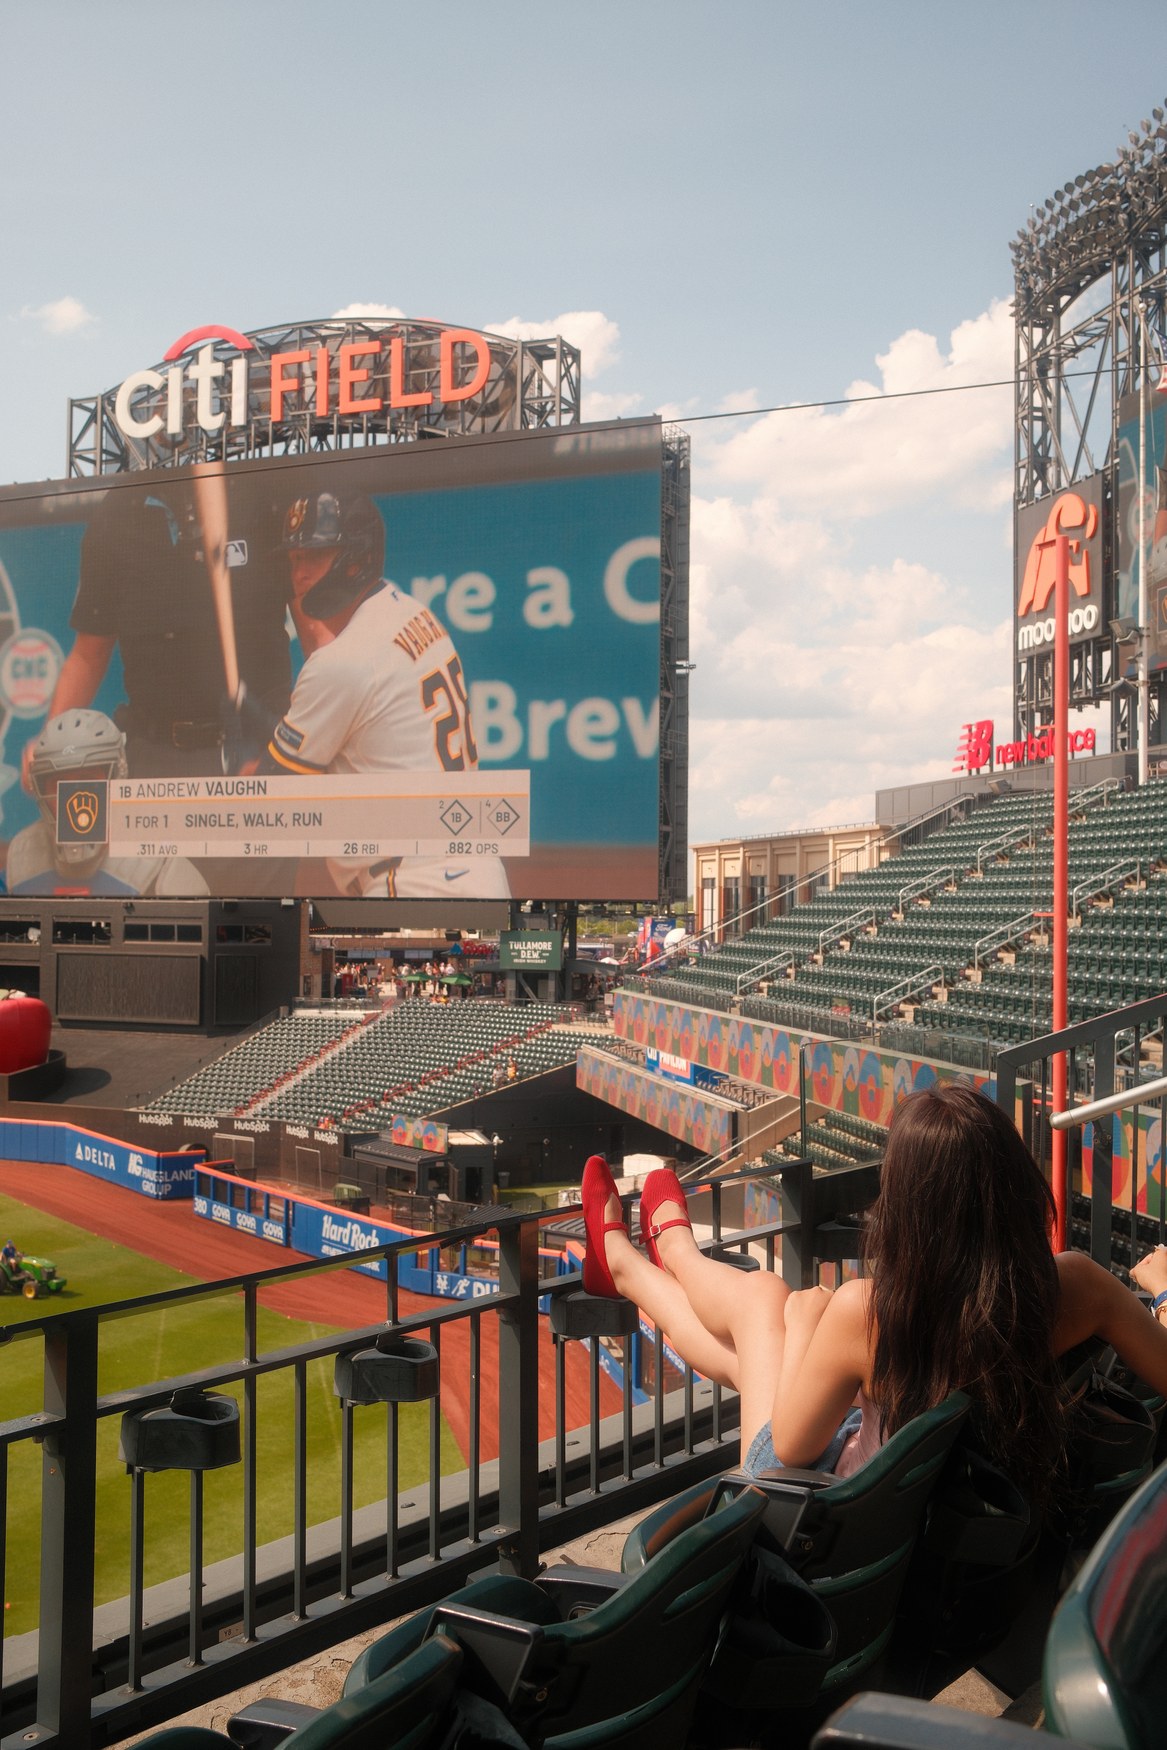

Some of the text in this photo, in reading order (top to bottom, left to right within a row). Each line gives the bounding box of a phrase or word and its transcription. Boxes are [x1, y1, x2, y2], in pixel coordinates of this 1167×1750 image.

[114, 329, 491, 439] citi FIELD
[522, 565, 575, 629] a
[392, 607, 449, 664] VAUGH
[1017, 604, 1098, 651] moooo
[995, 727, 1096, 765] new balnce
[119, 780, 268, 798] 1B ANDREW VAUGHN
[439, 800, 445, 809] 2
[451, 812, 462, 823] 1B
[496, 812, 510, 822] BB
[125, 812, 323, 829] 1 FOR 1 SINGLE, WALK, RUN
[137, 843, 178, 855] .311 AVG
[244, 843, 268, 854] 3 HR
[343, 843, 379, 854] 26 RBI
[445, 842, 499, 854] .882 OPS
[509, 941, 552, 950] TULLAMORE
[138, 1114, 173, 1126] HubSpot
[183, 1116, 219, 1129] HubSpot
[234, 1120, 270, 1133] HubSpot
[286, 1124, 309, 1139] HubSpot
[314, 1130, 338, 1145] HubSpot
[84, 1145, 116, 1171] DELTA
[212, 1203, 231, 1221] GOYA
[236, 1213, 257, 1230] GOYA
[262, 1221, 284, 1239] GOYA
[322, 1215, 350, 1245] Hard
[351, 1223, 380, 1251] Rock
